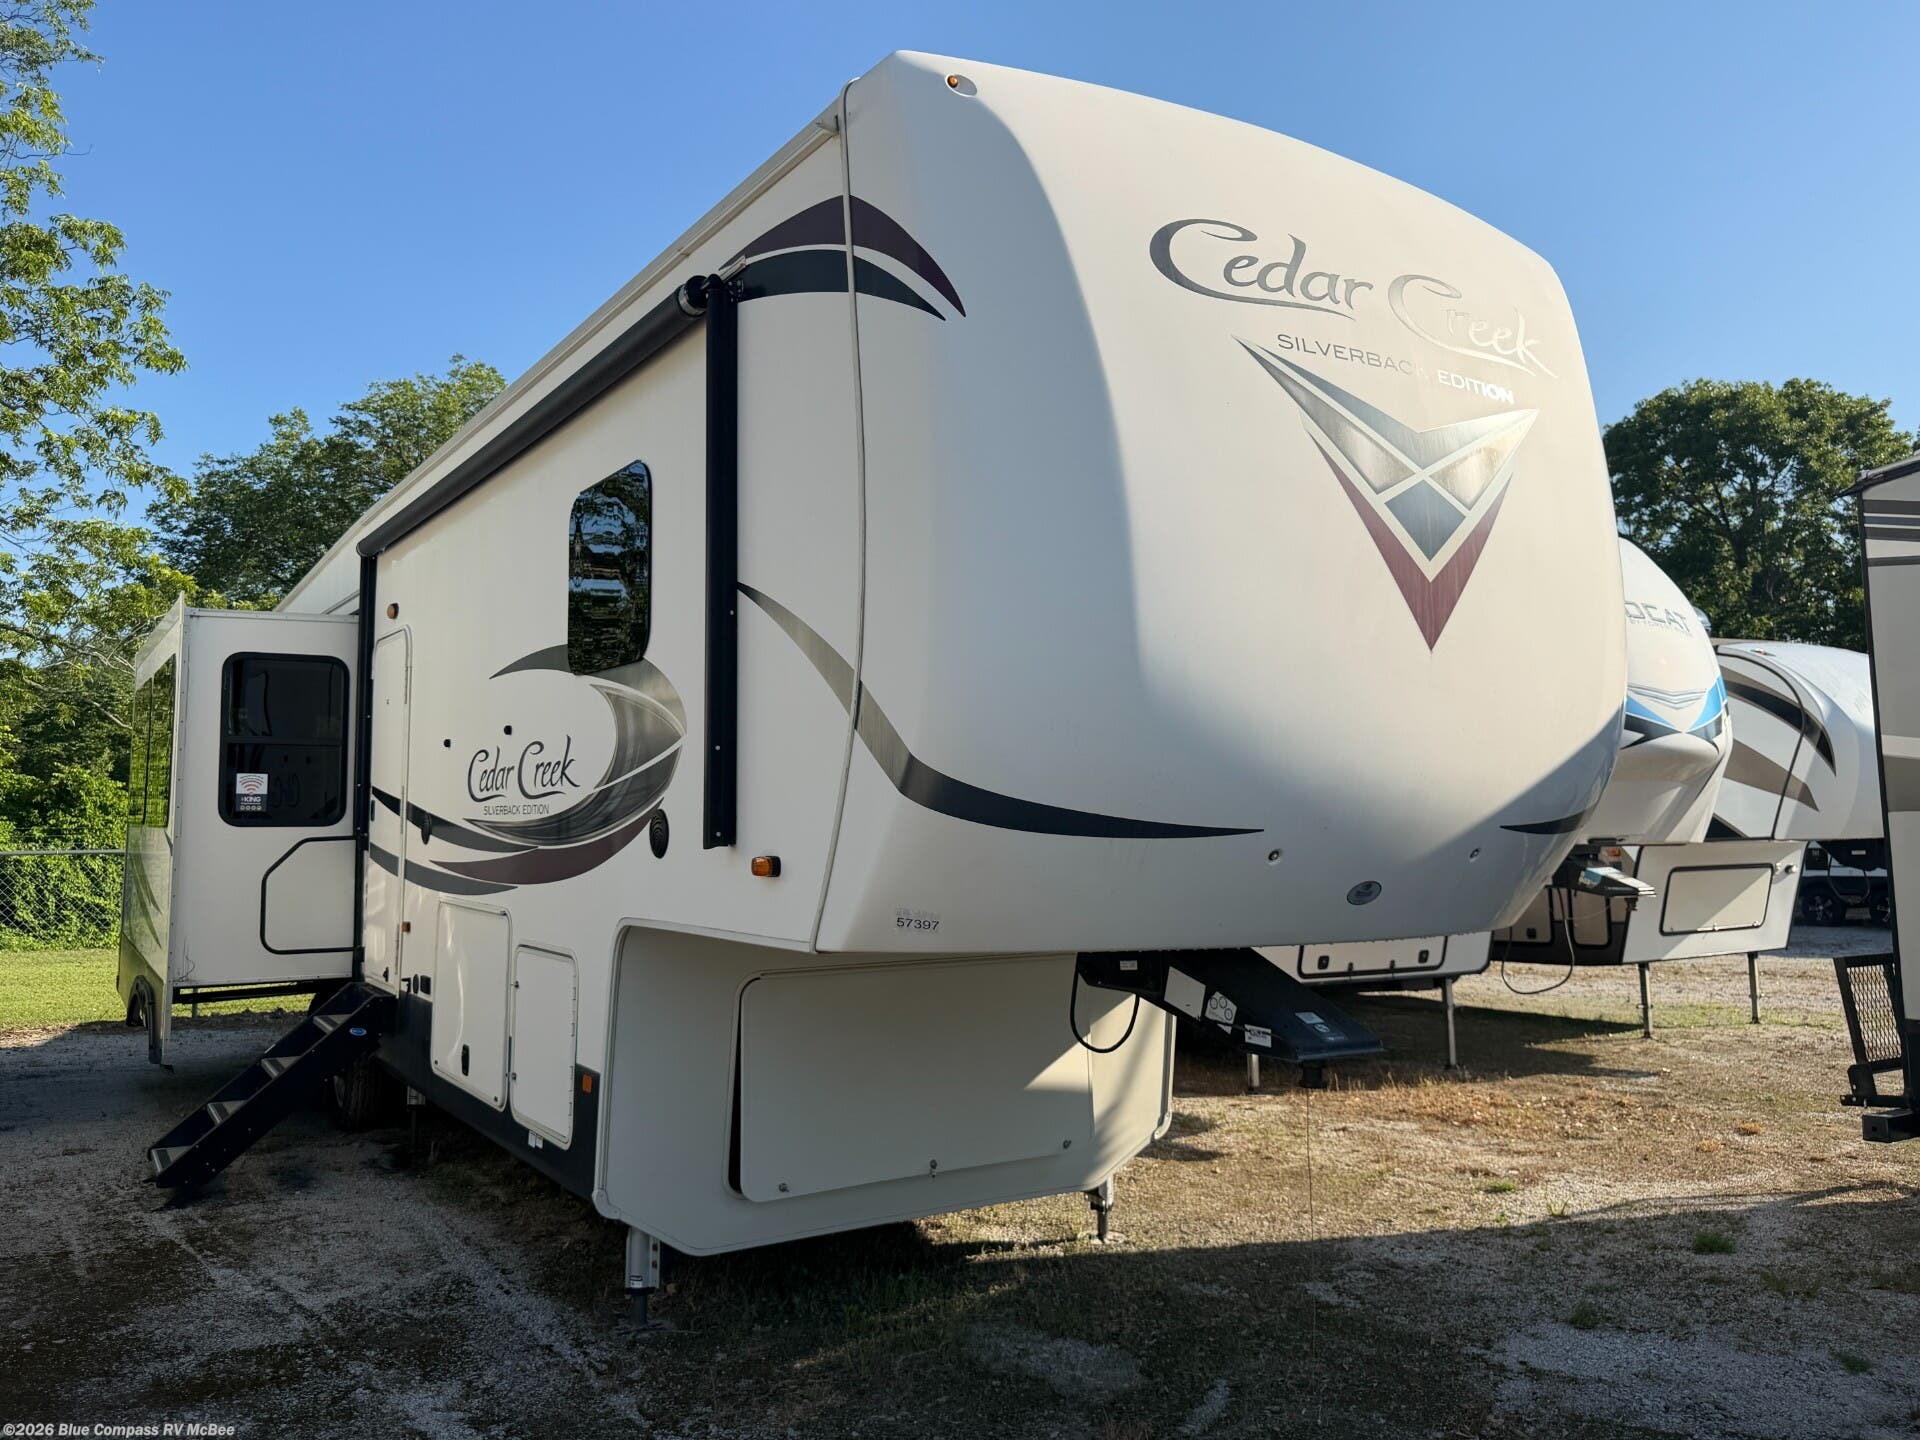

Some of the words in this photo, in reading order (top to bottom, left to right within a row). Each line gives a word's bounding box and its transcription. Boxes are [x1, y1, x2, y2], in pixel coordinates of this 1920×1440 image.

[1149, 218, 1374, 321] Cedar
[1388, 274, 1559, 379] Creek
[1438, 370, 1515, 405] EDITION
[467, 746, 515, 802] Cedar
[517, 734, 581, 800] Creek
[483, 805, 521, 816] SILVERBACK
[522, 804, 550, 815] EDITION
[896, 917, 940, 930] 57397
